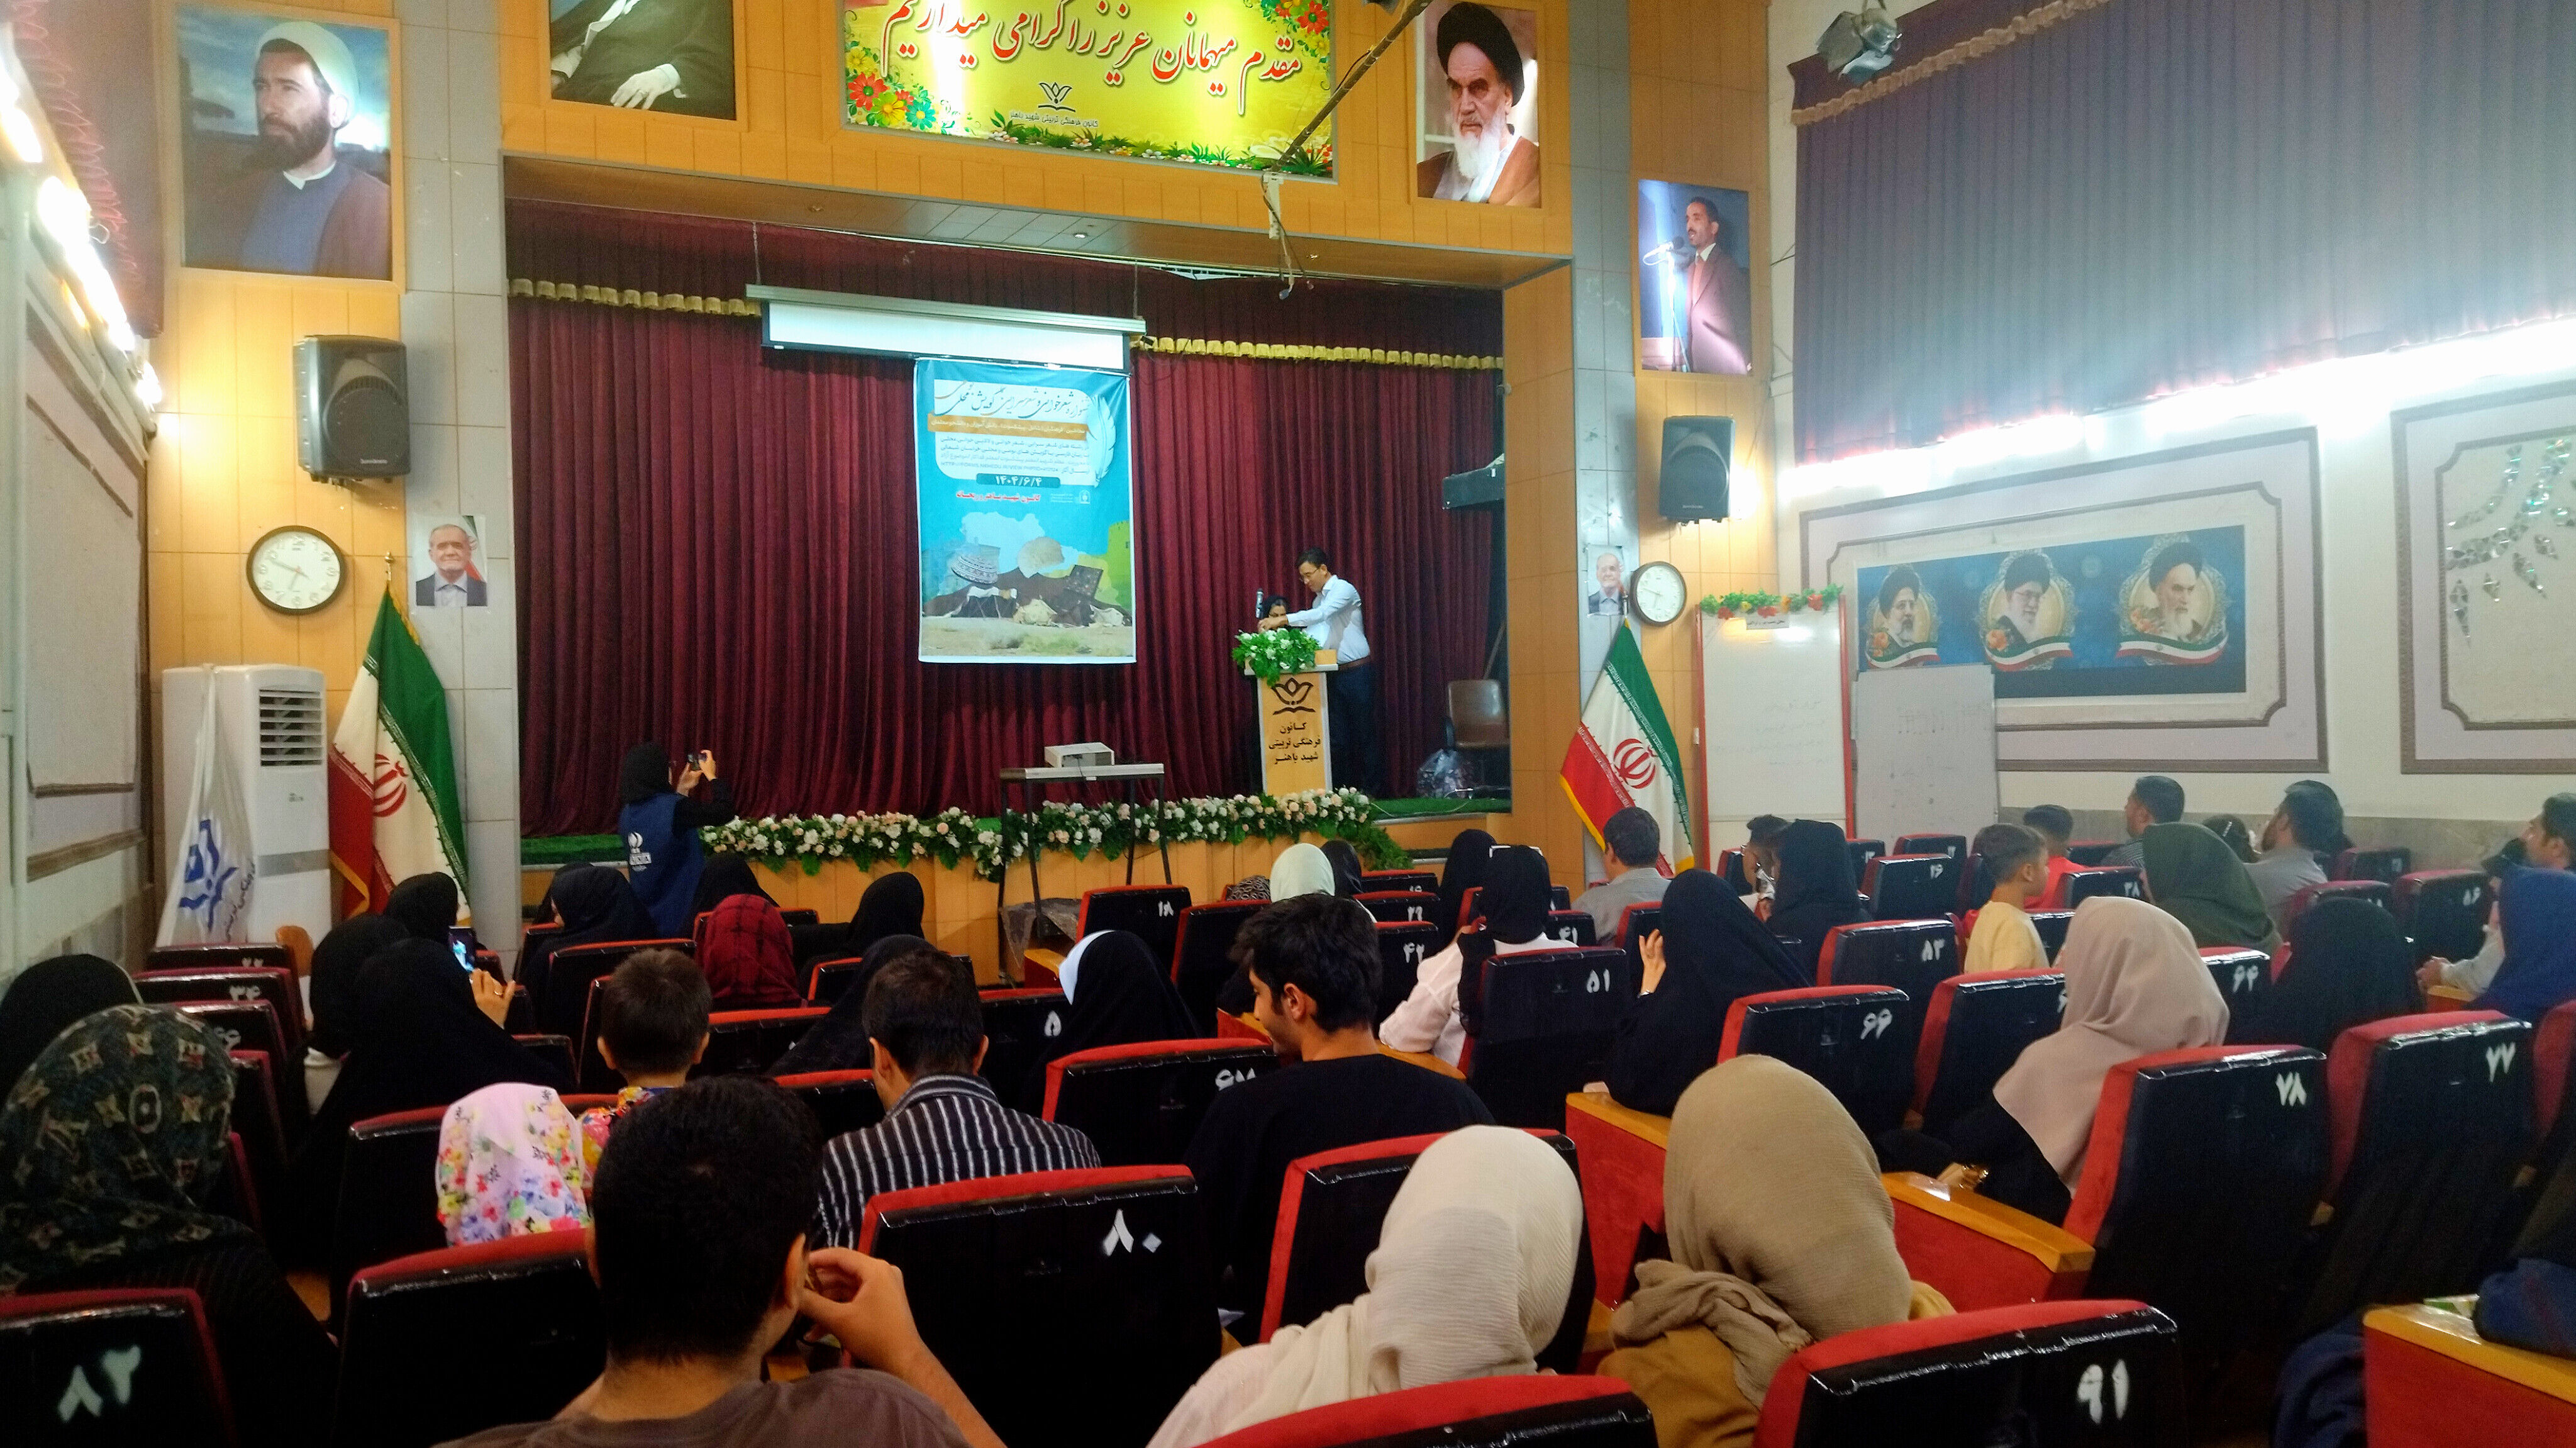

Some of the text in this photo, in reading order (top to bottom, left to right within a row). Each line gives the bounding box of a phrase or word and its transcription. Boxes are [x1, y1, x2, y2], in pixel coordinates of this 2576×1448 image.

[1096, 0, 1152, 87] عزیز
[1152, 9, 1237, 96] میهمانان
[1236, 34, 1302, 116] مقدم
[1269, 735, 1321, 750] فرهنگی تربیتی
[1279, 722, 1307, 734] کانون
[1274, 752, 1318, 765] شهید باهنر
[1158, 900, 1174, 917] ۱۸
[1585, 969, 1611, 993] ۵۱
[1860, 1008, 1893, 1040] ۶۶
[2275, 1071, 2307, 1107] ۷۸
[1102, 1208, 1162, 1257] ۸۰
[58, 1344, 142, 1424] ۸۲
[2077, 1359, 2129, 1424] ۹۱
